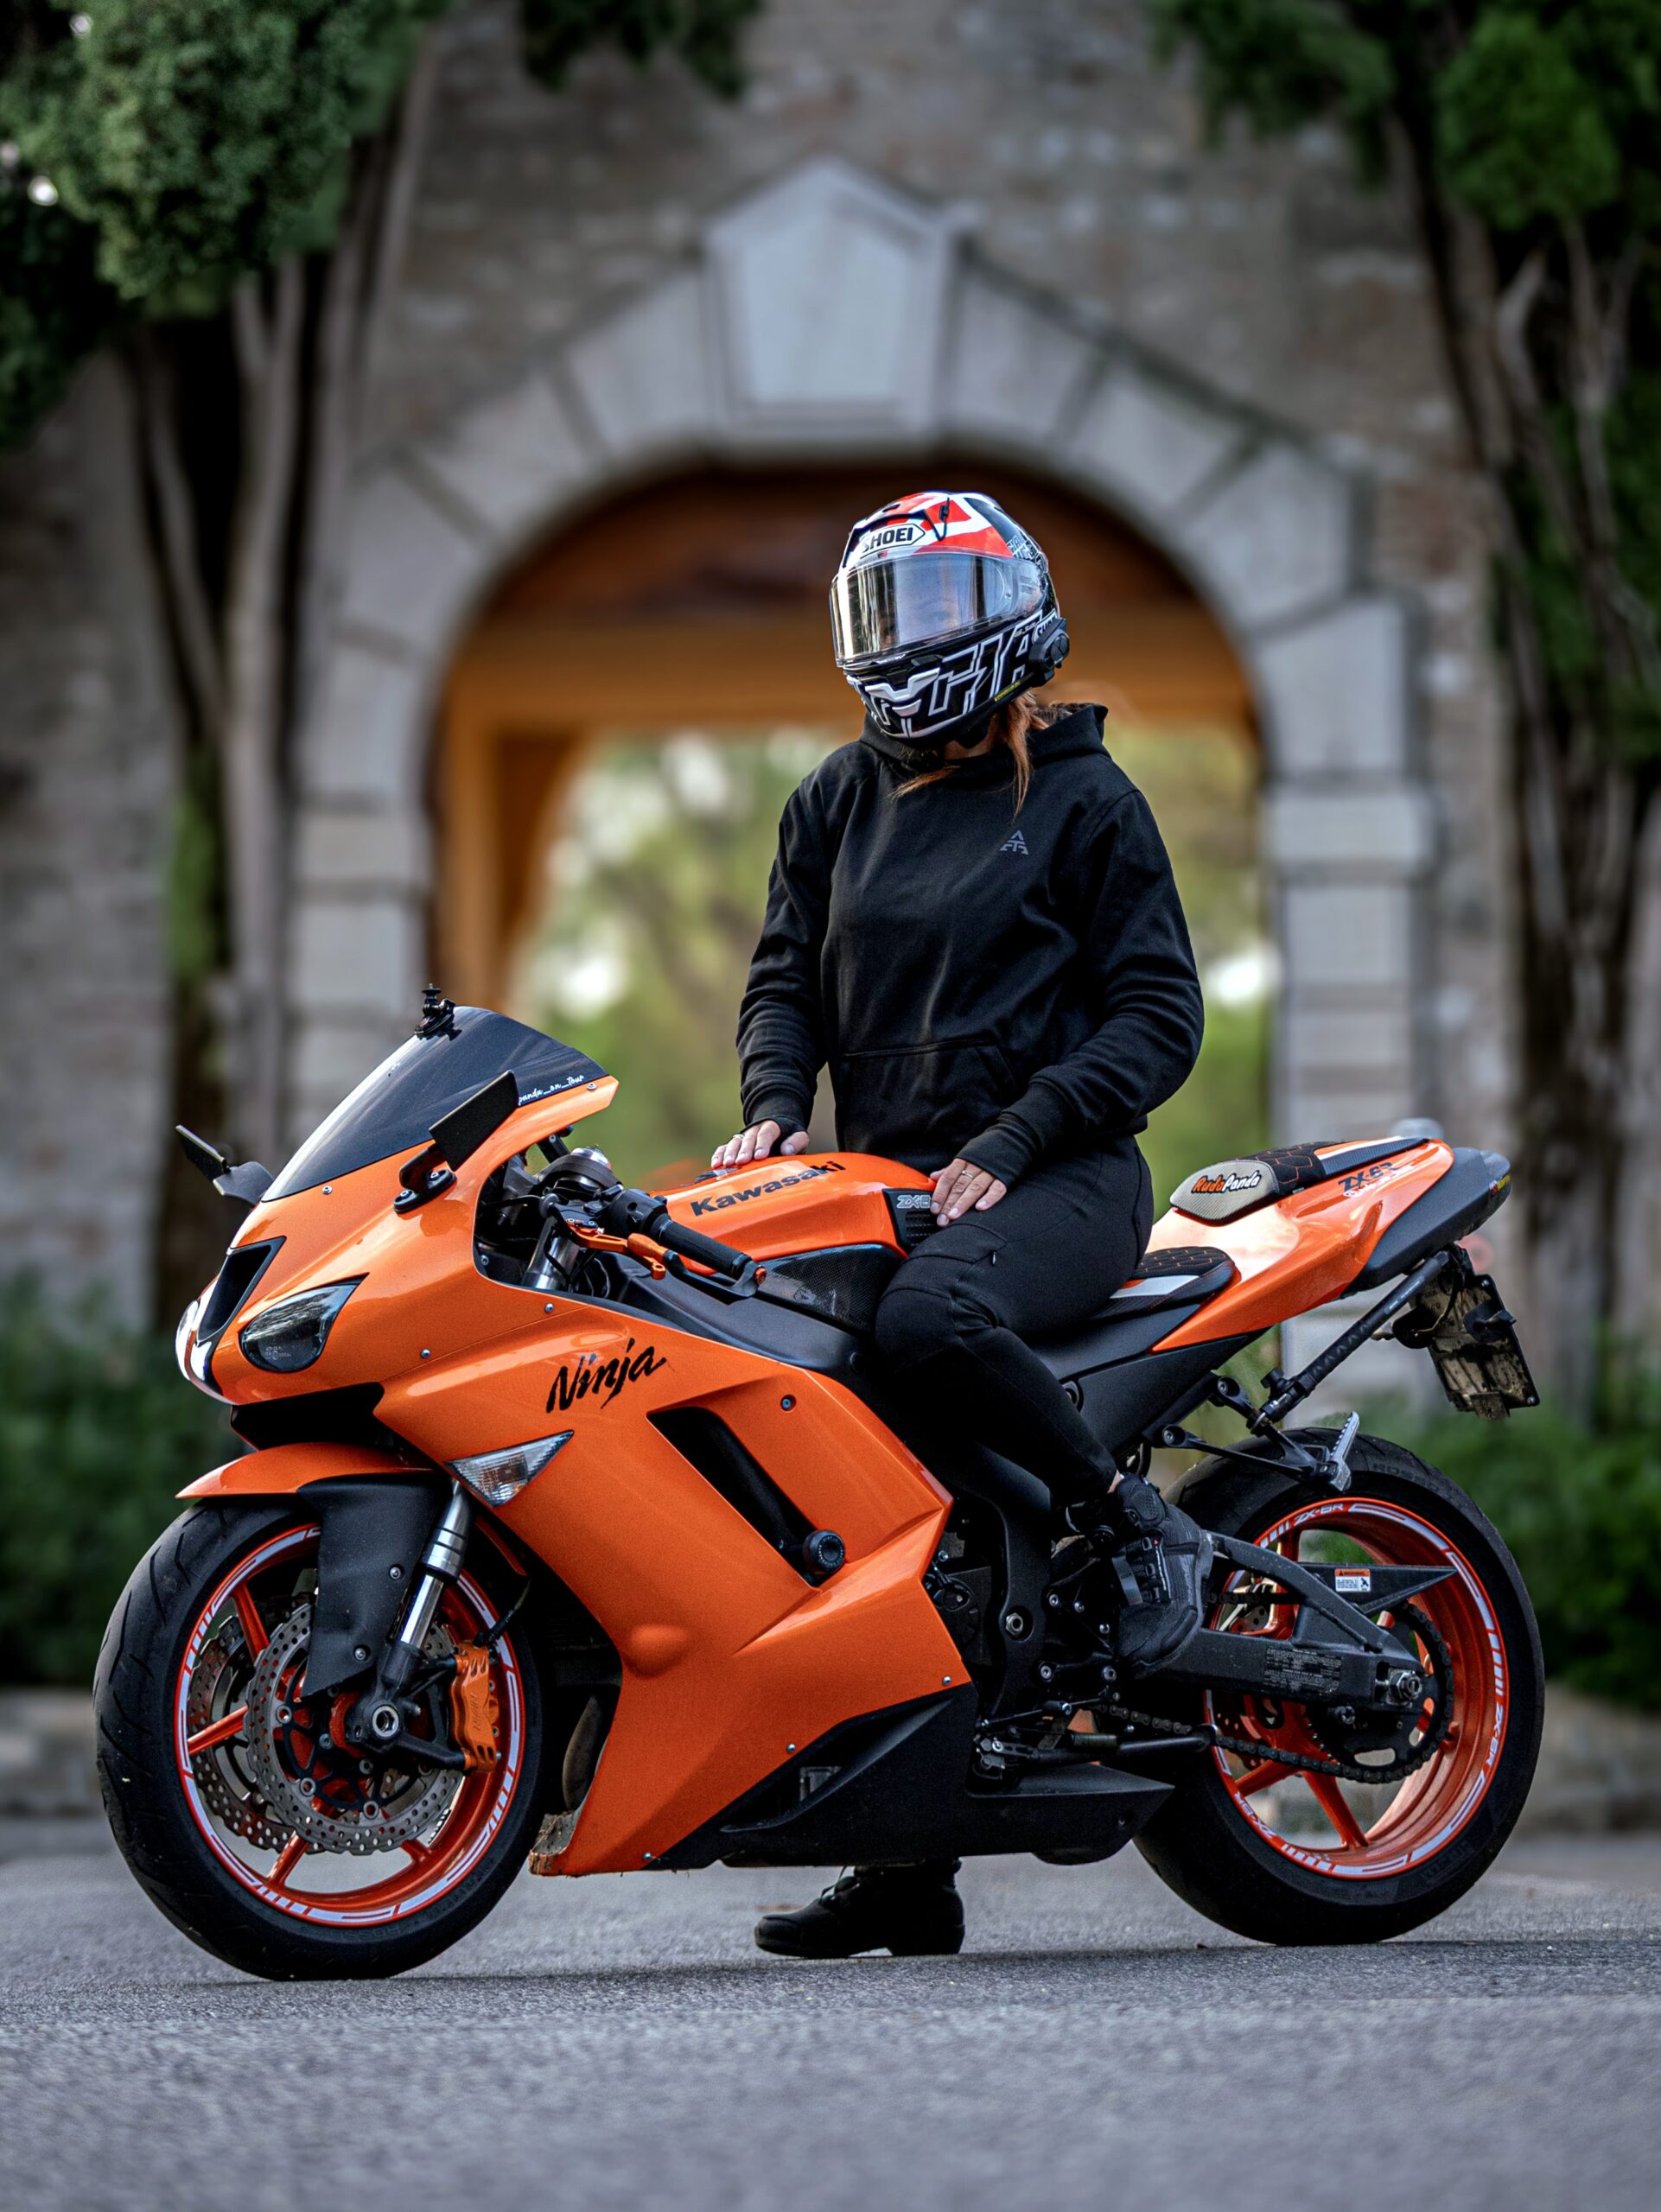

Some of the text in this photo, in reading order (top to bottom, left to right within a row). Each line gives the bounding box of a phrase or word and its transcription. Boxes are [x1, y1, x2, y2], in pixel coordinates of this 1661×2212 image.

[862, 526, 913, 552] SHOEI
[690, 1160, 846, 1217] Kawasaki
[897, 1194, 932, 1209] ZX-6
[545, 1337, 667, 1414] Ninja
[1294, 1503, 1344, 1527] ZX-6R
